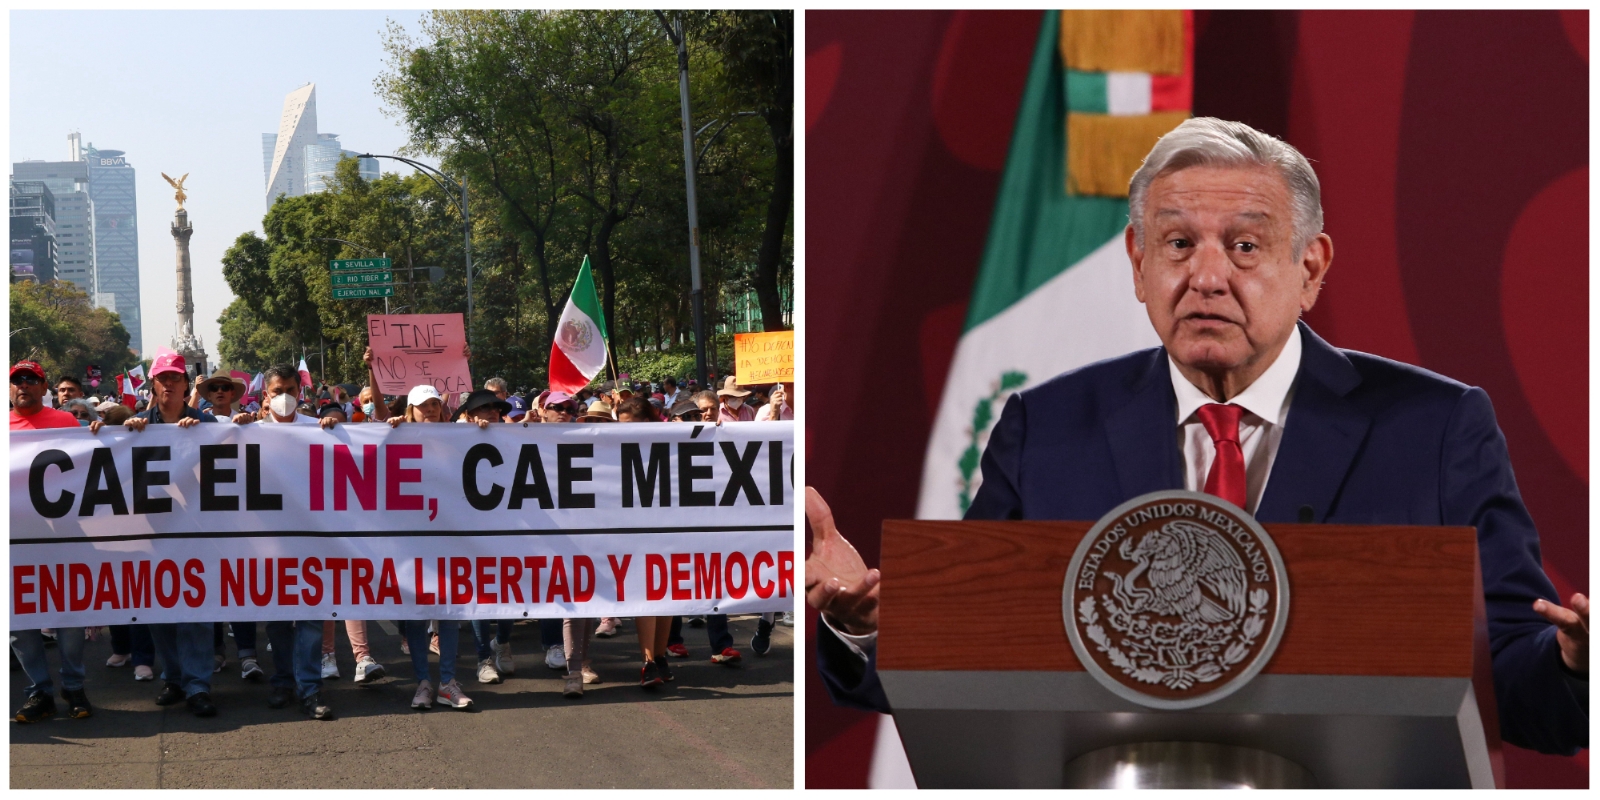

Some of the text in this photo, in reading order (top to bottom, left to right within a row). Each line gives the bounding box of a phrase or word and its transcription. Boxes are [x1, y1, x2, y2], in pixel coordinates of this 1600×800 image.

[100, 158, 125, 166] BBVA
[345, 260, 374, 268] SEVILLA
[347, 275, 358, 283] RIO
[361, 274, 379, 282] TIBER
[337, 289, 366, 297] EJERCITO
[390, 323, 448, 349] INE
[377, 355, 432, 380] NO SE
[740, 354, 794, 368] LA DEMOCR
[422, 376, 470, 393] TOCA
[28, 425, 794, 522] CAE EL INE, CAE MÉXI
[1078, 503, 1270, 590] ESTADOS UNIDOS MEXICANOS
[13, 550, 794, 615] ENDAMOS NUESTRA LIBERTAD Y DEMOCR
